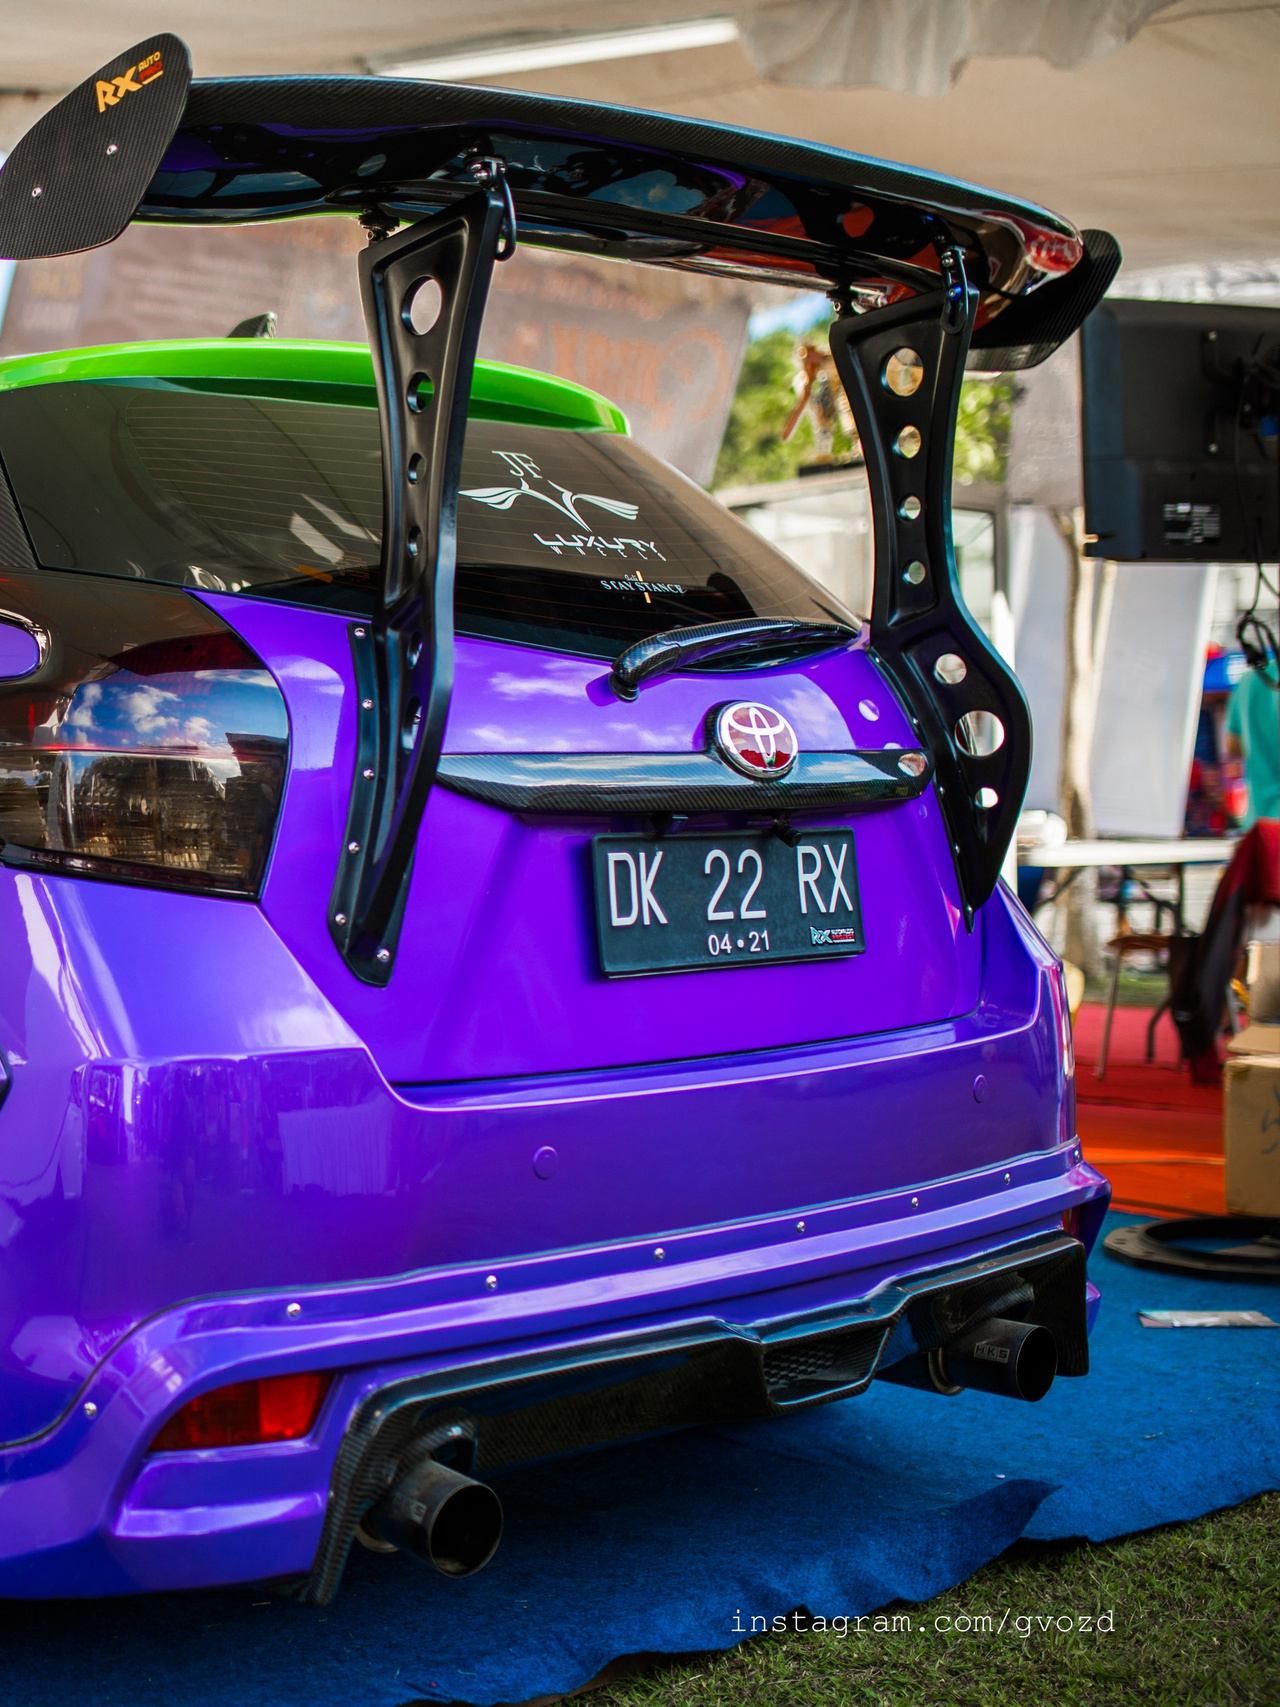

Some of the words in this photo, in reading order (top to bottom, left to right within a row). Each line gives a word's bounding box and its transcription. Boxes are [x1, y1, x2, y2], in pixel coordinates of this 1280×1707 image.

[138, 51, 161, 73] AUTO
[95, 65, 143, 114] RX
[533, 532, 658, 554] LUXURY
[600, 579, 636, 591] STAY
[634, 581, 687, 595] STANCE
[607, 850, 668, 926] DK
[704, 848, 767, 921] 22
[796, 842, 854, 914] RX
[974, 1343, 1010, 1364] HKS
